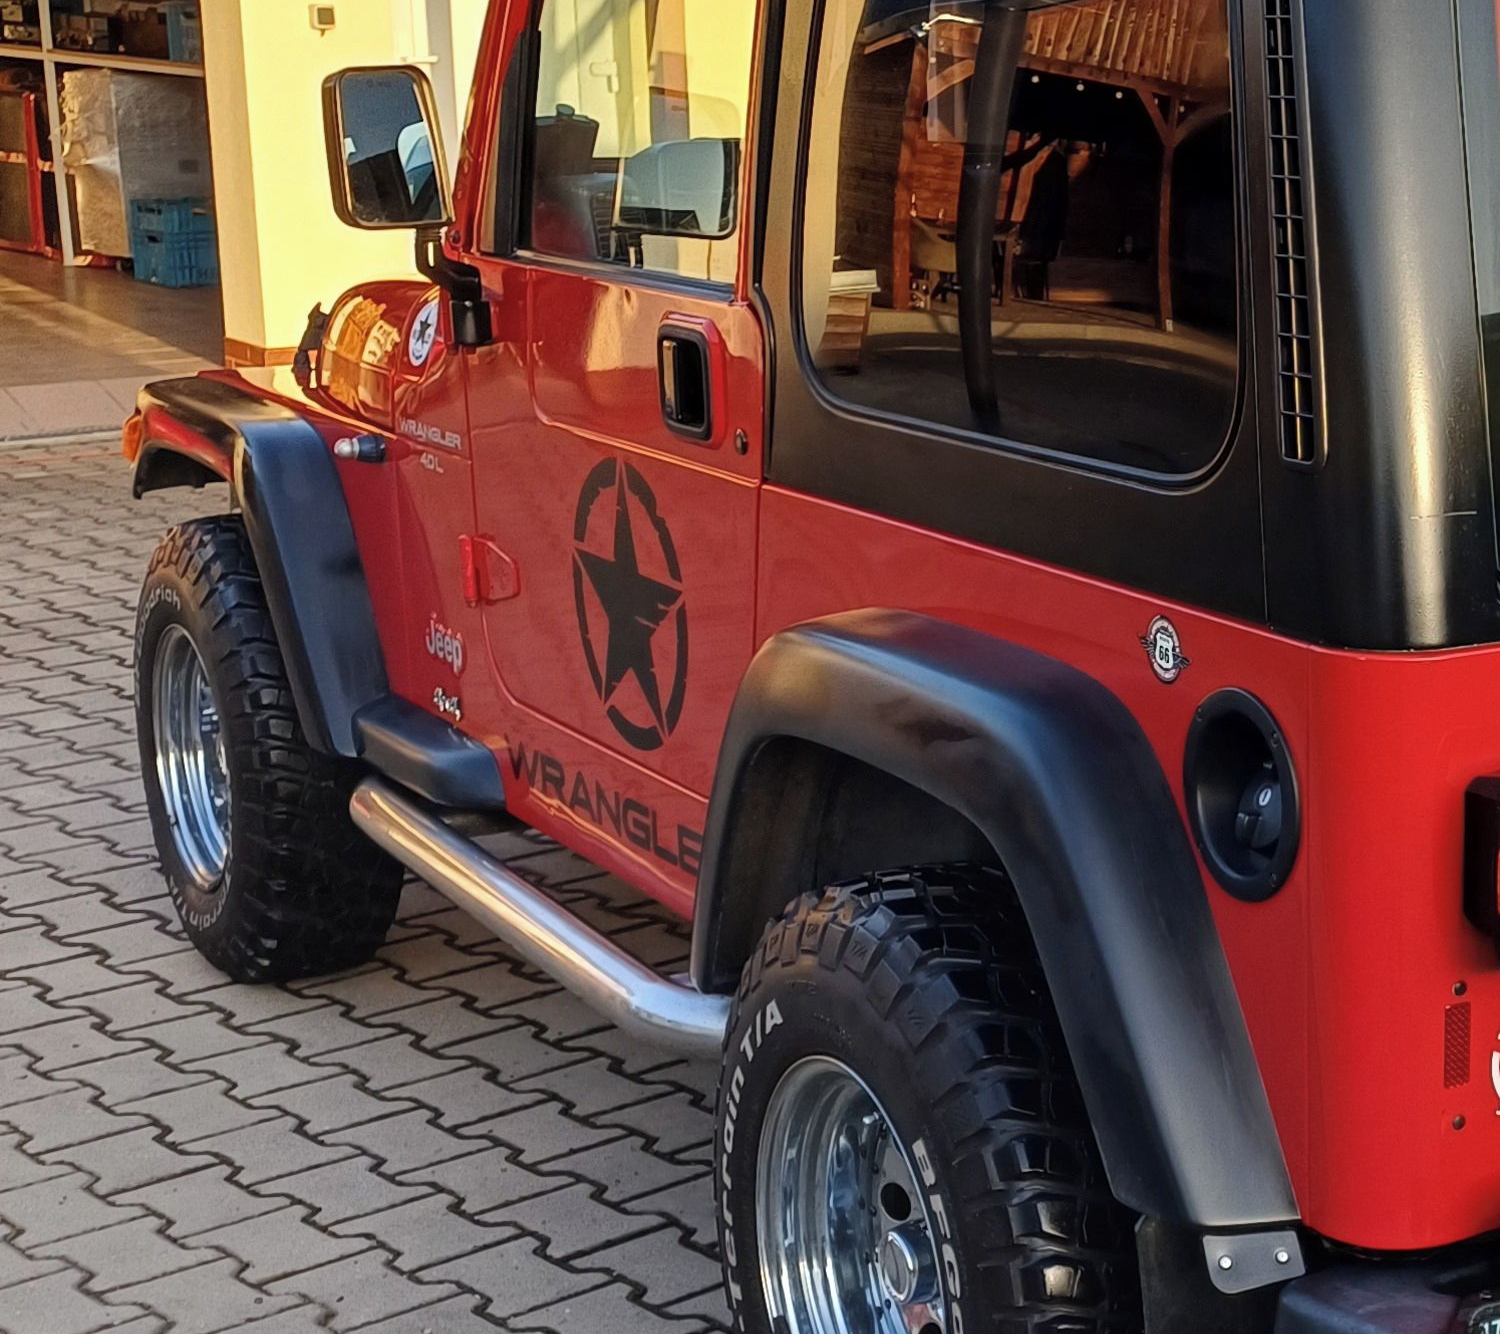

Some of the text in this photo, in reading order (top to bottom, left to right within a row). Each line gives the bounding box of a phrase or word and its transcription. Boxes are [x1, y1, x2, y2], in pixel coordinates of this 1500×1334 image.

[399, 417, 462, 451] WRANGLER
[426, 618, 463, 676] Jeep
[1158, 645, 1170, 664] 66
[740, 998, 784, 1062] T/A
